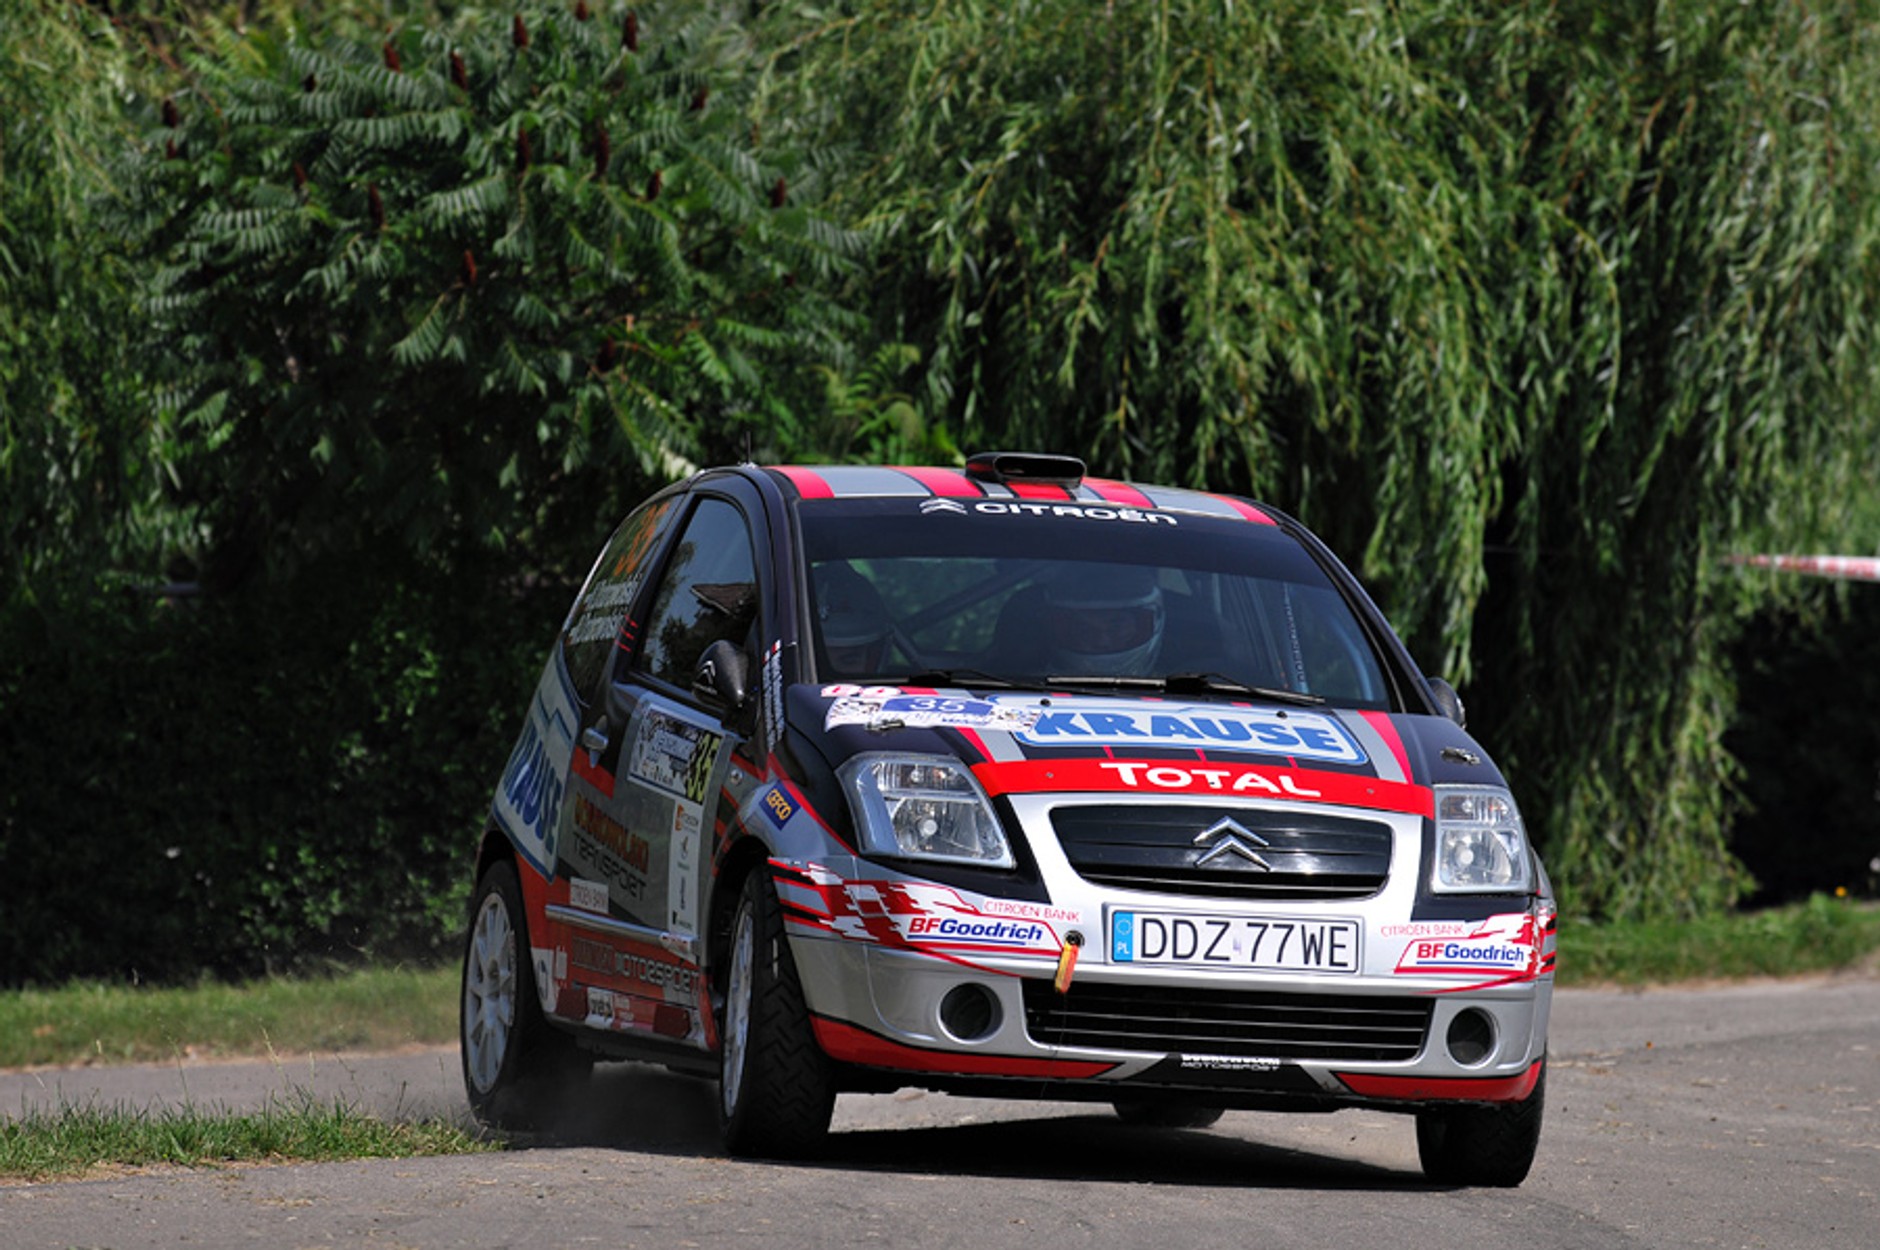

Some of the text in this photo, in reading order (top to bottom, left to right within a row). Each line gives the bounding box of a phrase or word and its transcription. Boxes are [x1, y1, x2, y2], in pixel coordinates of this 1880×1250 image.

[909, 698, 965, 712] 35
[1033, 712, 1345, 753] KRAUSE
[688, 733, 721, 802] 35
[1100, 763, 1322, 798] TOTAL
[503, 715, 562, 856] KRAUSE
[1044, 905, 1081, 922] BANK
[909, 917, 1043, 940] BFGoodrich
[1140, 918, 1349, 967] DDZ 77WE
[1117, 941, 1129, 954] PL
[1416, 943, 1524, 962] BFGoodrich
